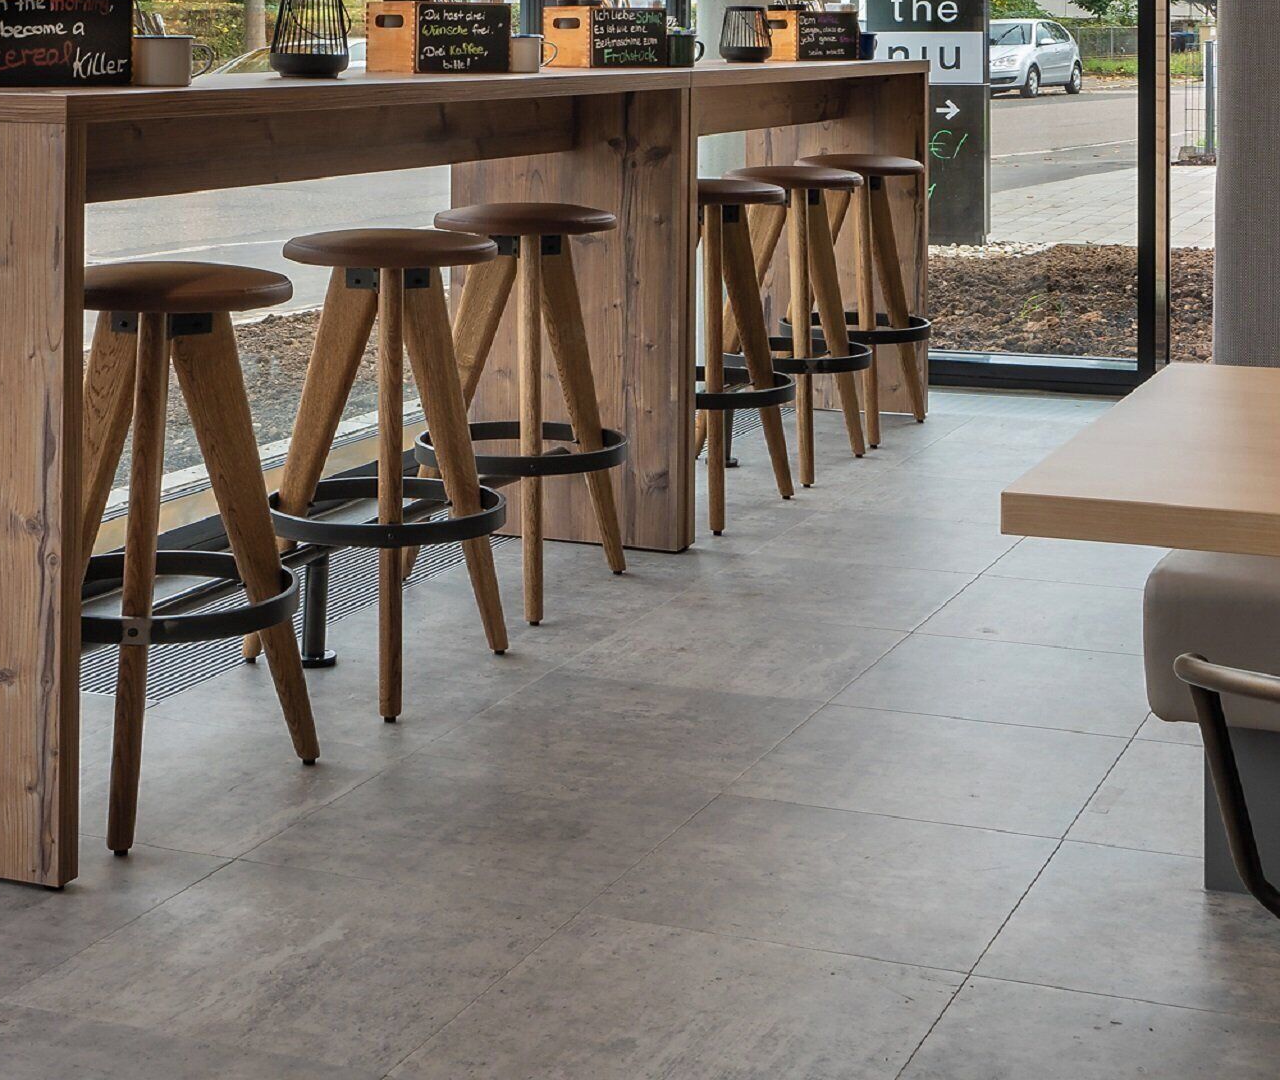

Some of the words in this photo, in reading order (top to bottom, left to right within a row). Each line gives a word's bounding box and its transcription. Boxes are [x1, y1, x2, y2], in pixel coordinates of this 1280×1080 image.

[443, 9, 464, 21] hast
[465, 11, 486, 21] drei
[594, 9, 609, 21] Ich
[0, 20, 68, 38] become
[72, 21, 85, 35] a
[422, 24, 469, 36] Wünsche
[594, 25, 604, 34] Es
[606, 24, 615, 33] ist
[630, 25, 648, 33] eine
